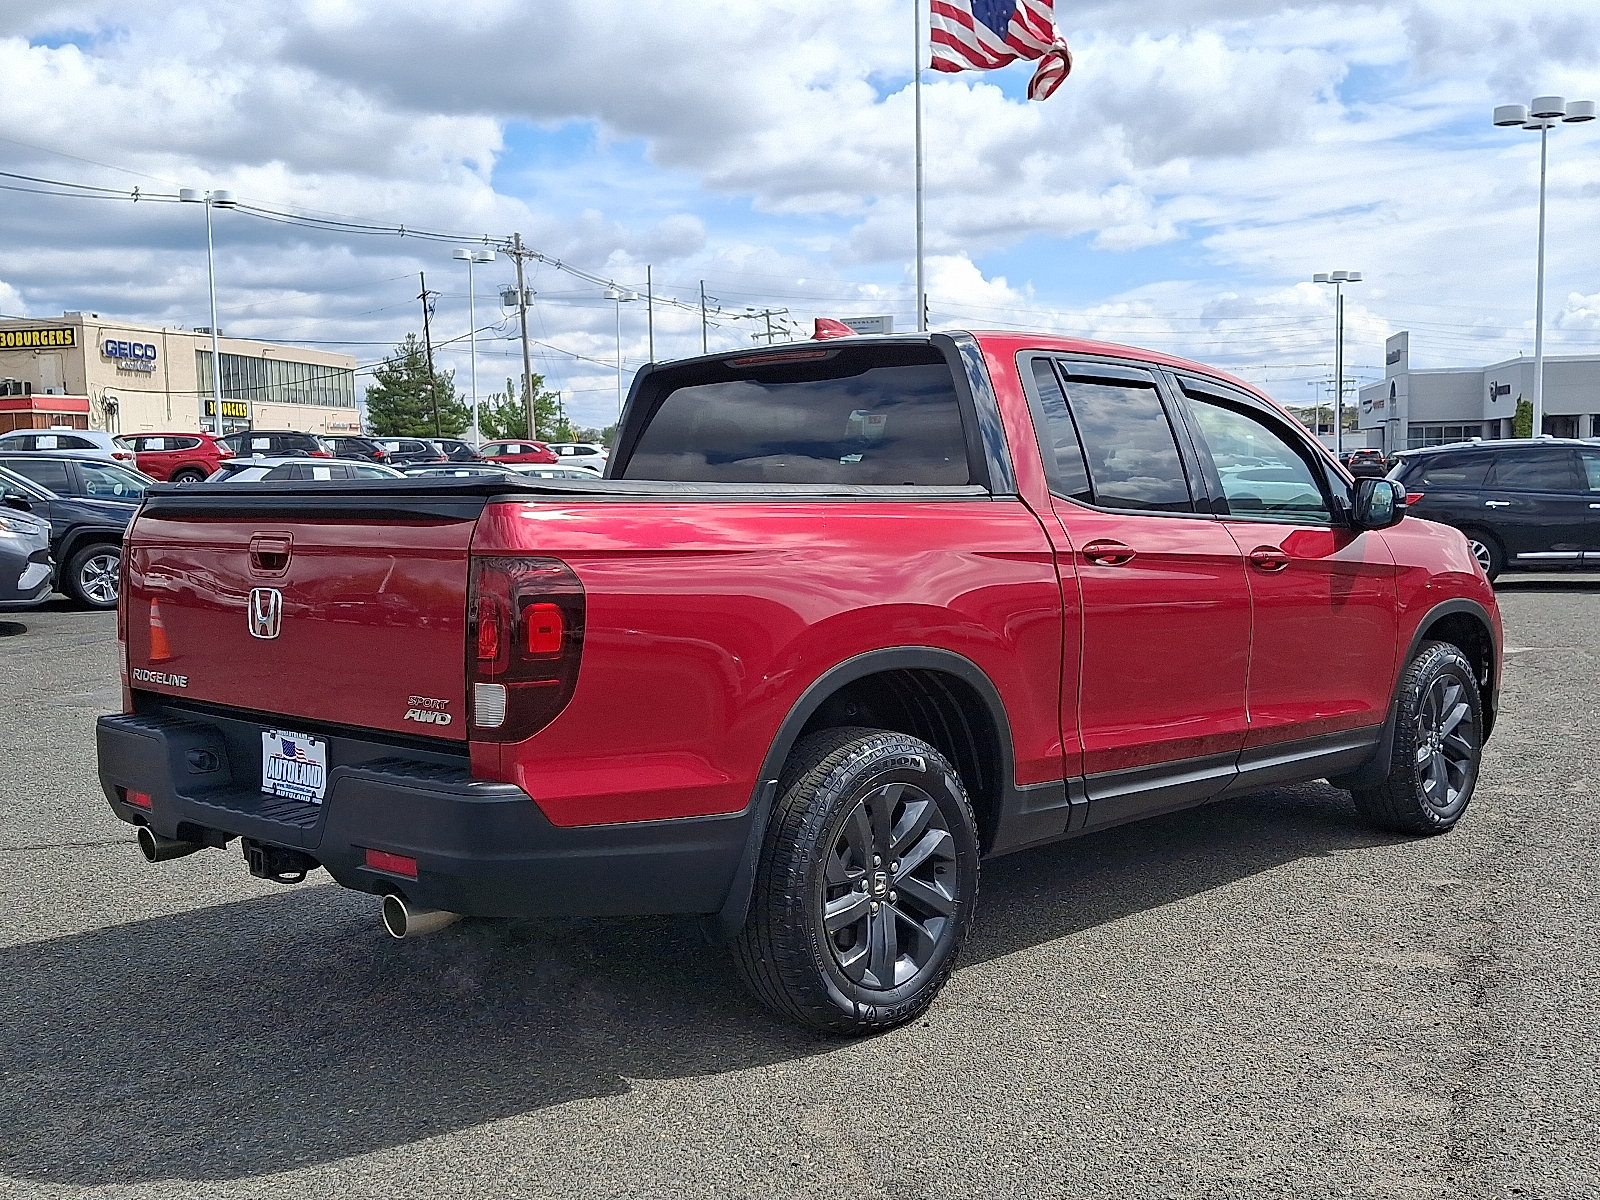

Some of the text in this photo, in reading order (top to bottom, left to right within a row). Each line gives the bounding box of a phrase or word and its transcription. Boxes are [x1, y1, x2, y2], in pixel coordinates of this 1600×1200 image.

[105, 339, 157, 361] GEICO
[209, 401, 247, 417] 3URGERS
[133, 667, 188, 688] RIDGELINE
[407, 695, 450, 710] SPORT
[403, 708, 452, 726] AWD
[267, 756, 324, 789] AUTOLAND
[275, 789, 311, 803] AUTOLAND
